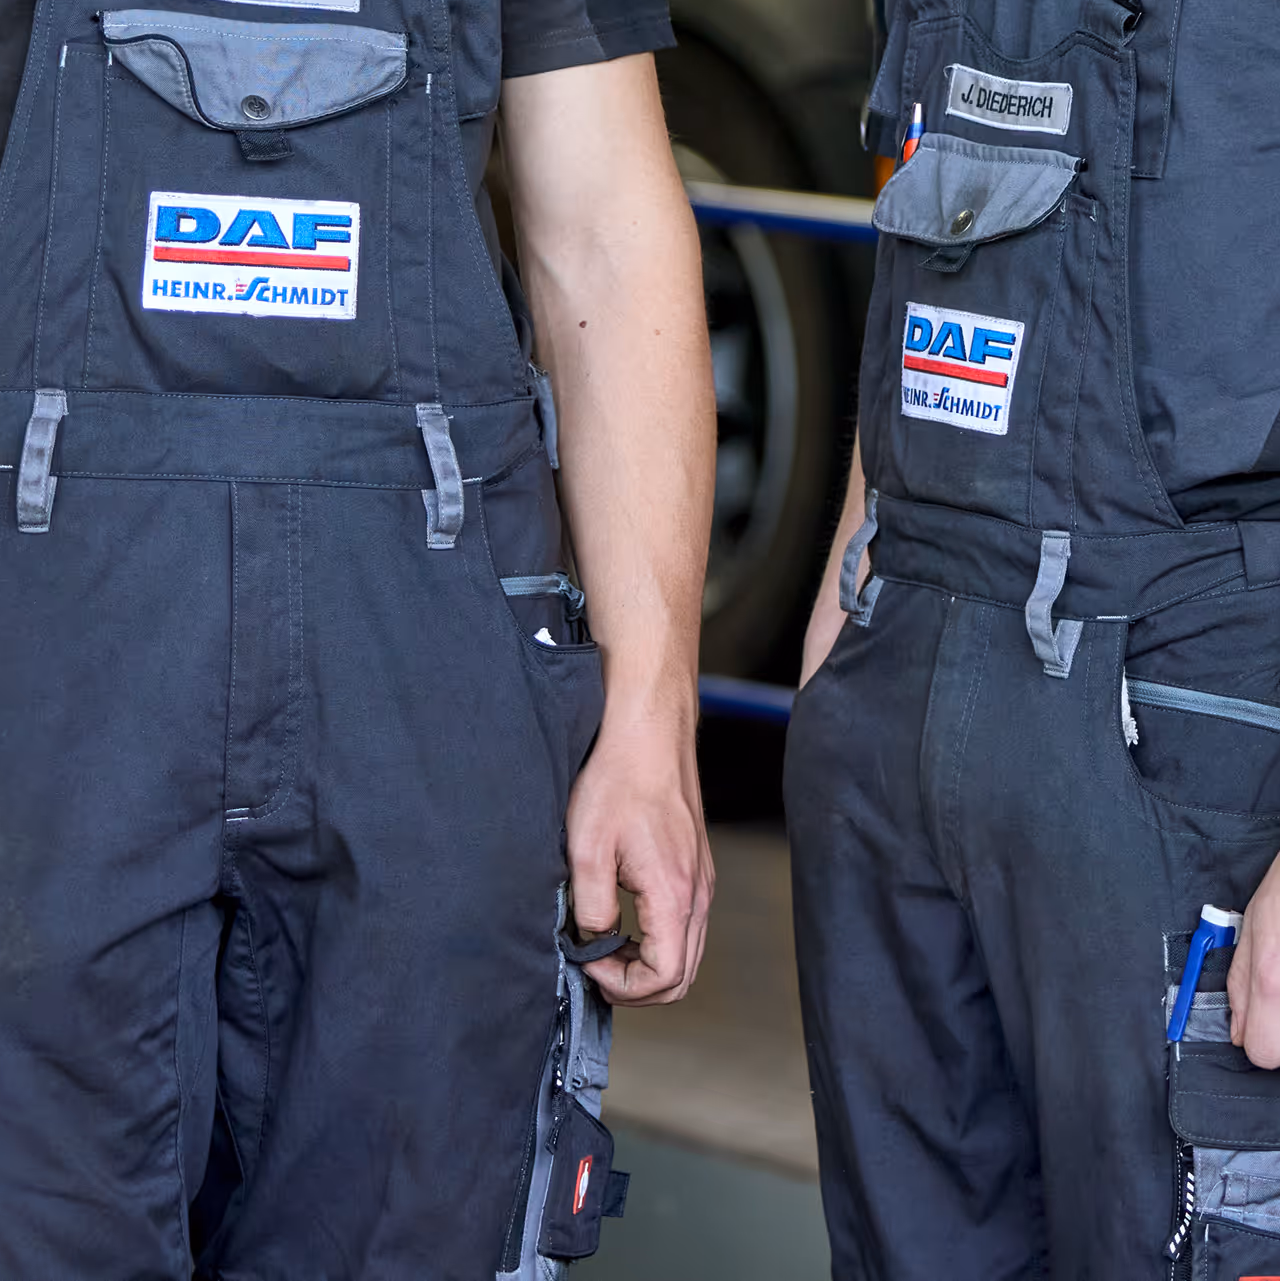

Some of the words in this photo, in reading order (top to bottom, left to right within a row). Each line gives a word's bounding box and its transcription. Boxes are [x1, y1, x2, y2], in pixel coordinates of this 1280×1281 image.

[961, 83, 974, 105] J.
[975, 86, 1053, 119] DIEDERICH
[154, 205, 352, 251] DAF
[905, 314, 1016, 365] DAF
